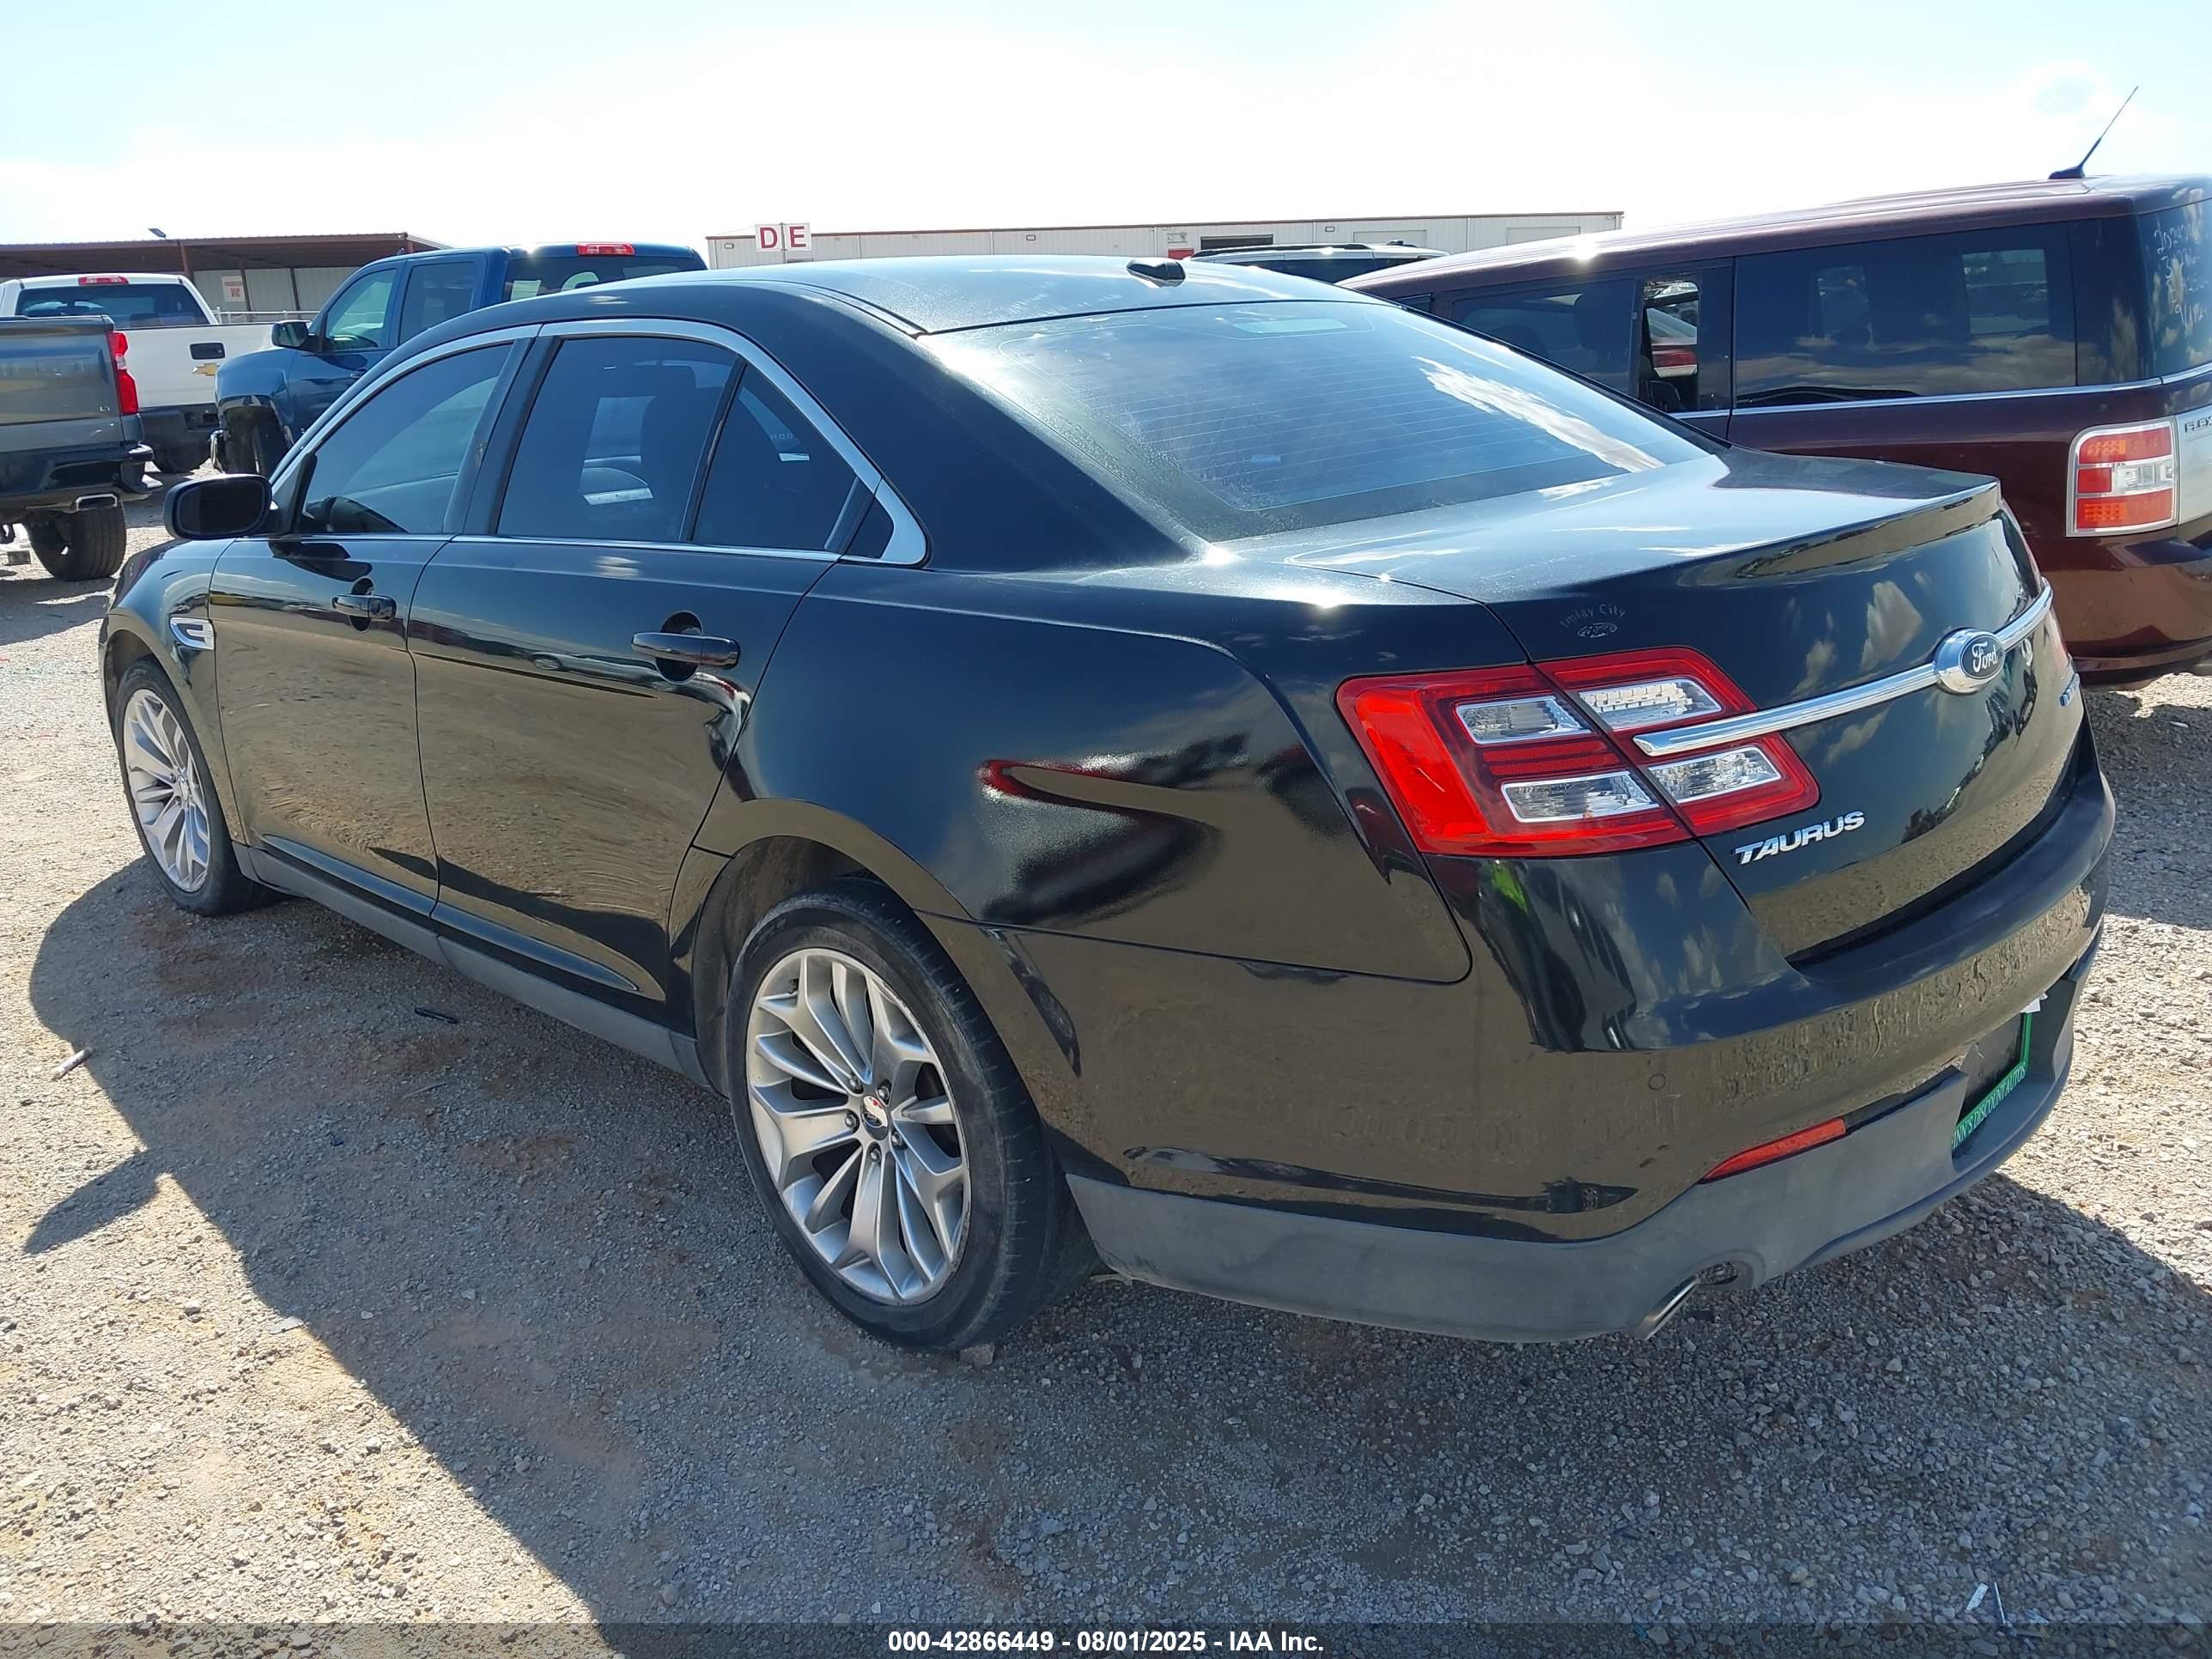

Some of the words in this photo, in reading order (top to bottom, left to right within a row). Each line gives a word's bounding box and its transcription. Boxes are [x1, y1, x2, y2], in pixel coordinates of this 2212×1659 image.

[759, 227, 778, 249] D
[789, 226, 806, 247] E
[1599, 604, 1626, 617] City
[1972, 641, 1998, 672] Ford
[1735, 811, 1865, 866] TAURUS
[1951, 1115, 1973, 1149] INN'S
[1973, 1082, 2006, 1129] DISCOUNT
[2005, 1062, 2026, 1097] AUTOS
